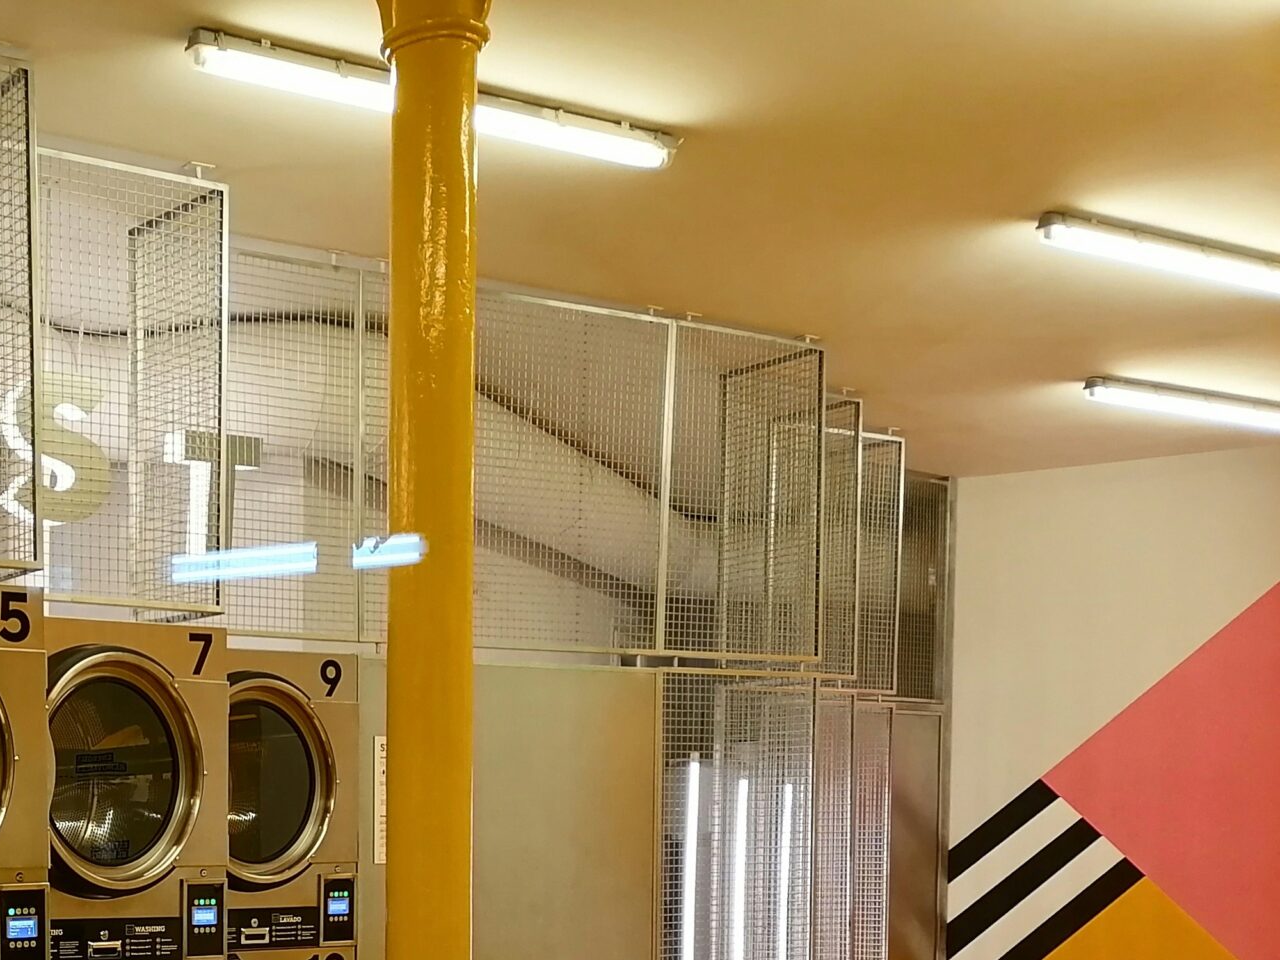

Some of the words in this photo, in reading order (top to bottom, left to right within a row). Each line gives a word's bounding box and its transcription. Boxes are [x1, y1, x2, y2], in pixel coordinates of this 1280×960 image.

[0, 591, 30, 642] 5
[189, 633, 212, 675] 7
[320, 660, 341, 697] 9
[135, 925, 165, 933] WASHING
